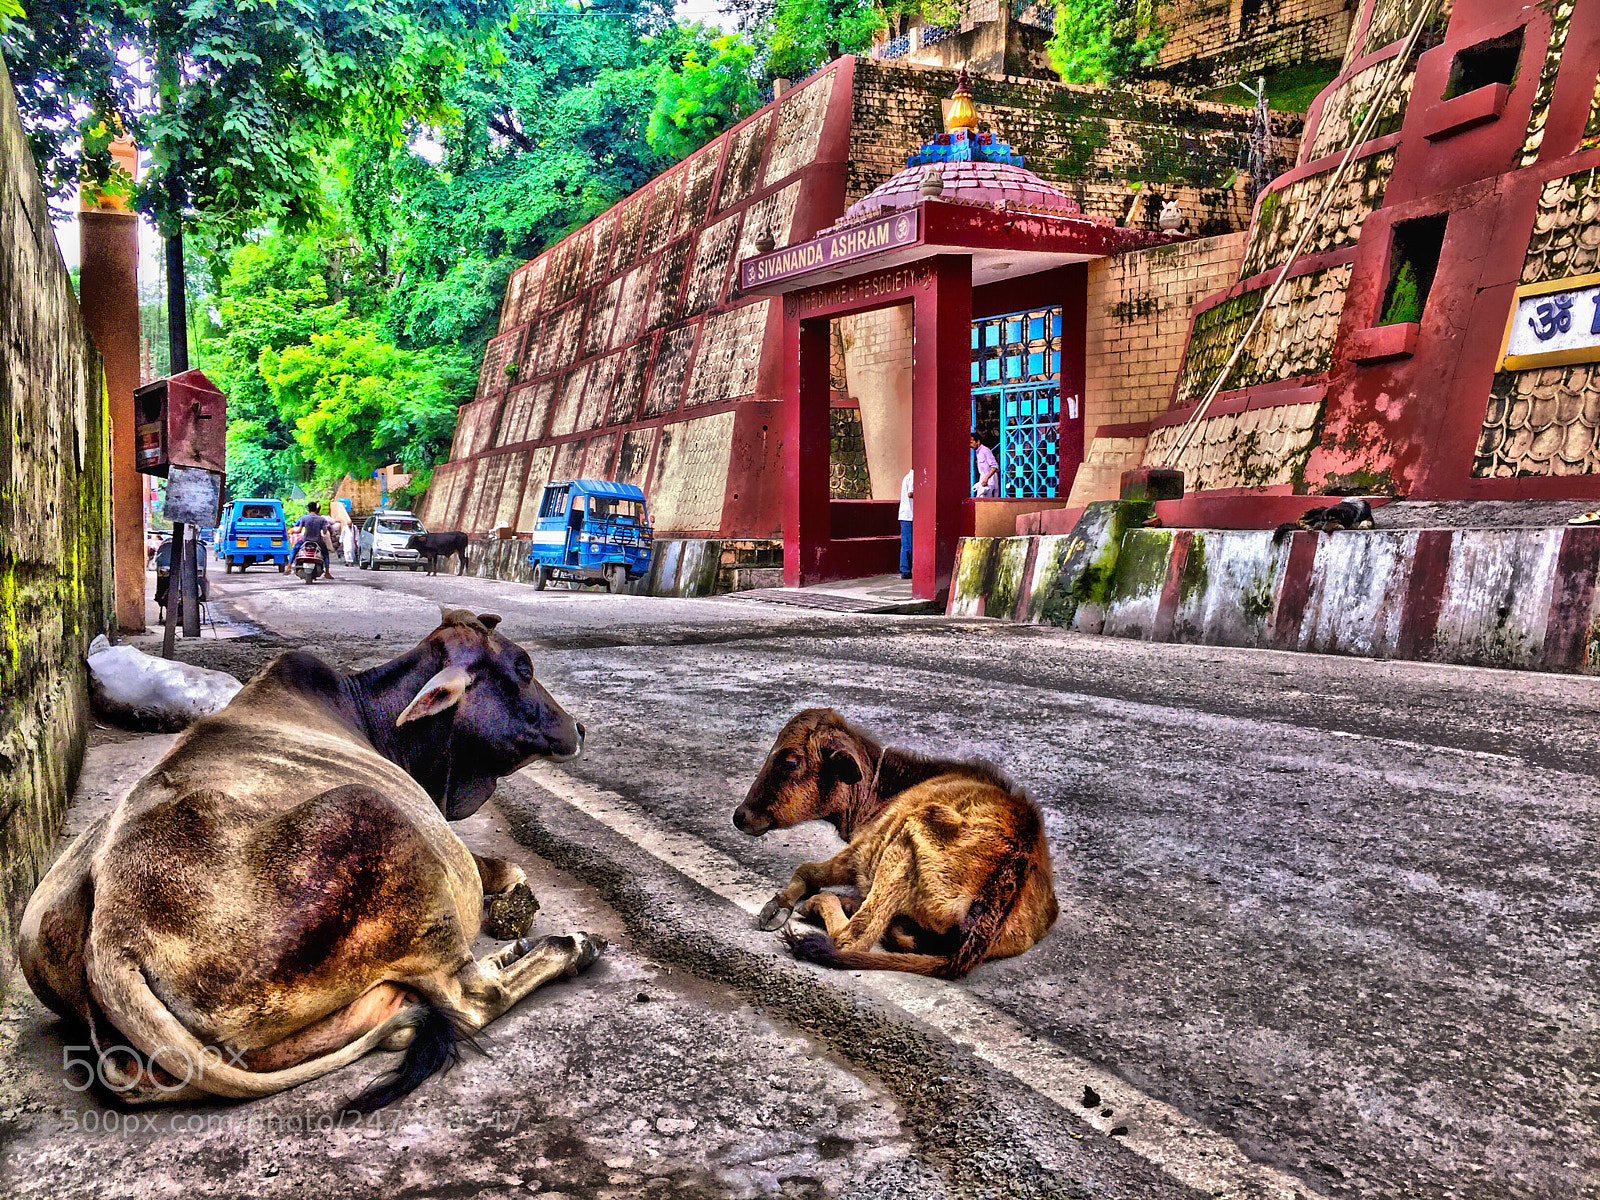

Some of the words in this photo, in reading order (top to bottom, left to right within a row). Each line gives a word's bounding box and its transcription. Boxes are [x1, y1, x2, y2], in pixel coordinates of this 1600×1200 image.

[757, 243, 823, 280] SIVANANDA
[830, 222, 889, 259] ASHRAM
[799, 291, 816, 312] THE
[847, 279, 870, 302] LIFE
[872, 269, 915, 296] SOCIETY
